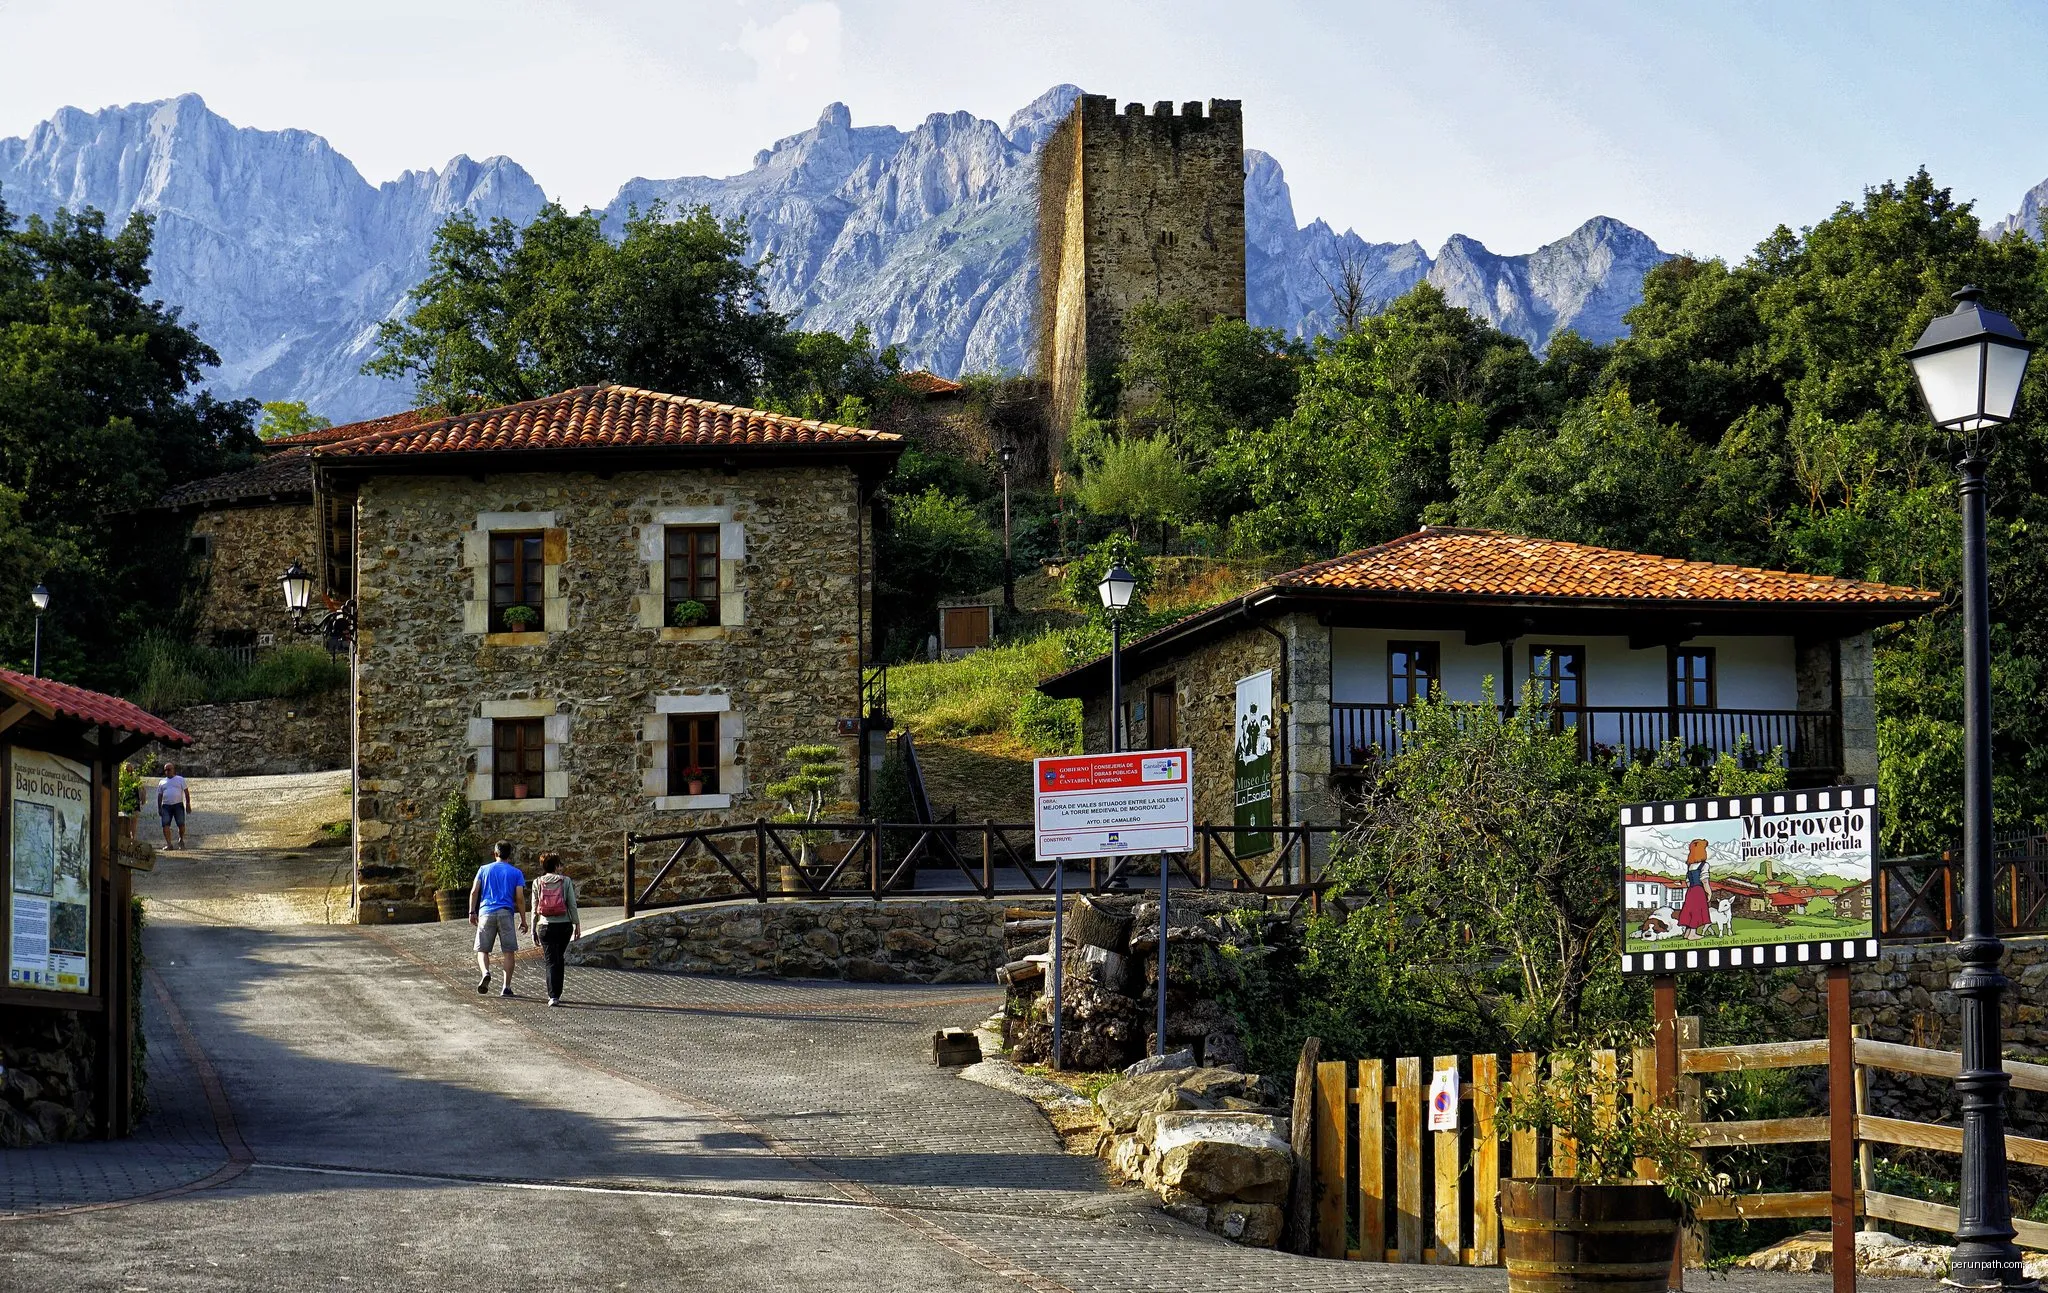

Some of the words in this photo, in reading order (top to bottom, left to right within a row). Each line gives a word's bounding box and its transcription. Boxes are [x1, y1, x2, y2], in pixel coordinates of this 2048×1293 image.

[41, 768, 61, 780] Comarca
[1236, 777, 1260, 790] Museo
[1261, 769, 1271, 783] de
[16, 772, 38, 796] Bajo
[40, 777, 54, 797] los
[57, 780, 82, 802] Picos
[1236, 791, 1246, 807] La
[1247, 784, 1271, 803] Escuela
[1098, 800, 1127, 808] SITUADOS
[1129, 804, 1166, 812] MOGROVEJO
[1111, 816, 1141, 824] CAMALEÑO
[1741, 809, 1864, 844] Mogrovejo
[1742, 841, 1785, 862] pueblo
[1790, 839, 1805, 854] de
[1810, 835, 1862, 856] película
[1629, 944, 1650, 952] Lugar
[1661, 941, 1685, 949] rodaje
[1703, 938, 1729, 947] trilogía
[1741, 936, 1772, 946] películas
[1818, 931, 1841, 939] Bhava
